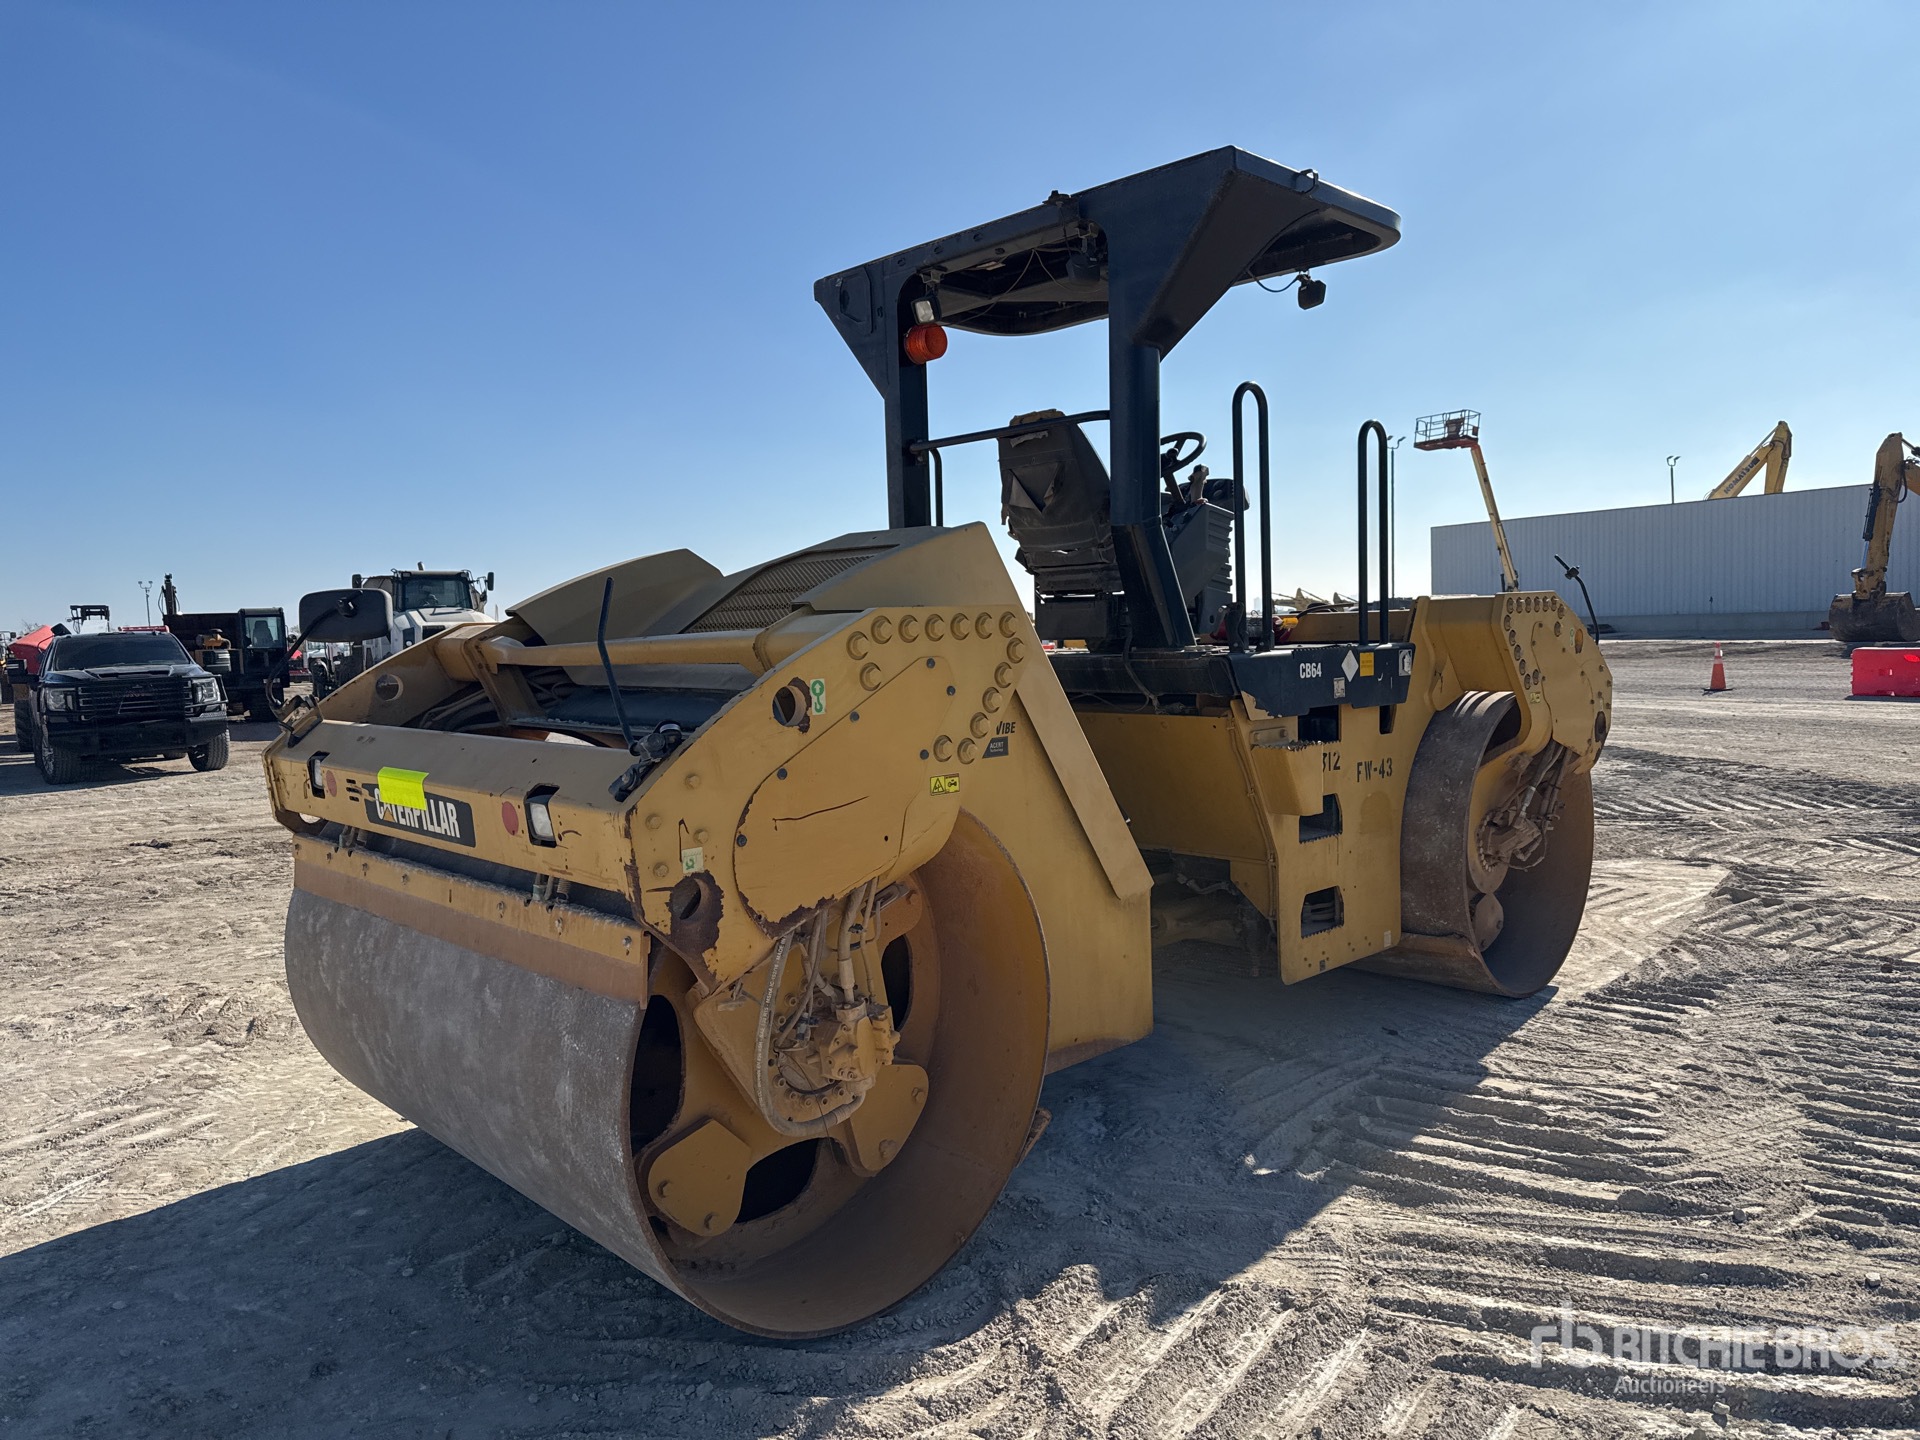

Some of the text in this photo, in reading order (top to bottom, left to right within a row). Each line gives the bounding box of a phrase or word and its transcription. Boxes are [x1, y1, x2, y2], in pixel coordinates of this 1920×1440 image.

[1724, 463, 1755, 493] KOMATSU
[1299, 662, 1322, 679] CB64
[996, 721, 1015, 735] VIBE
[1357, 757, 1393, 783] FW-43
